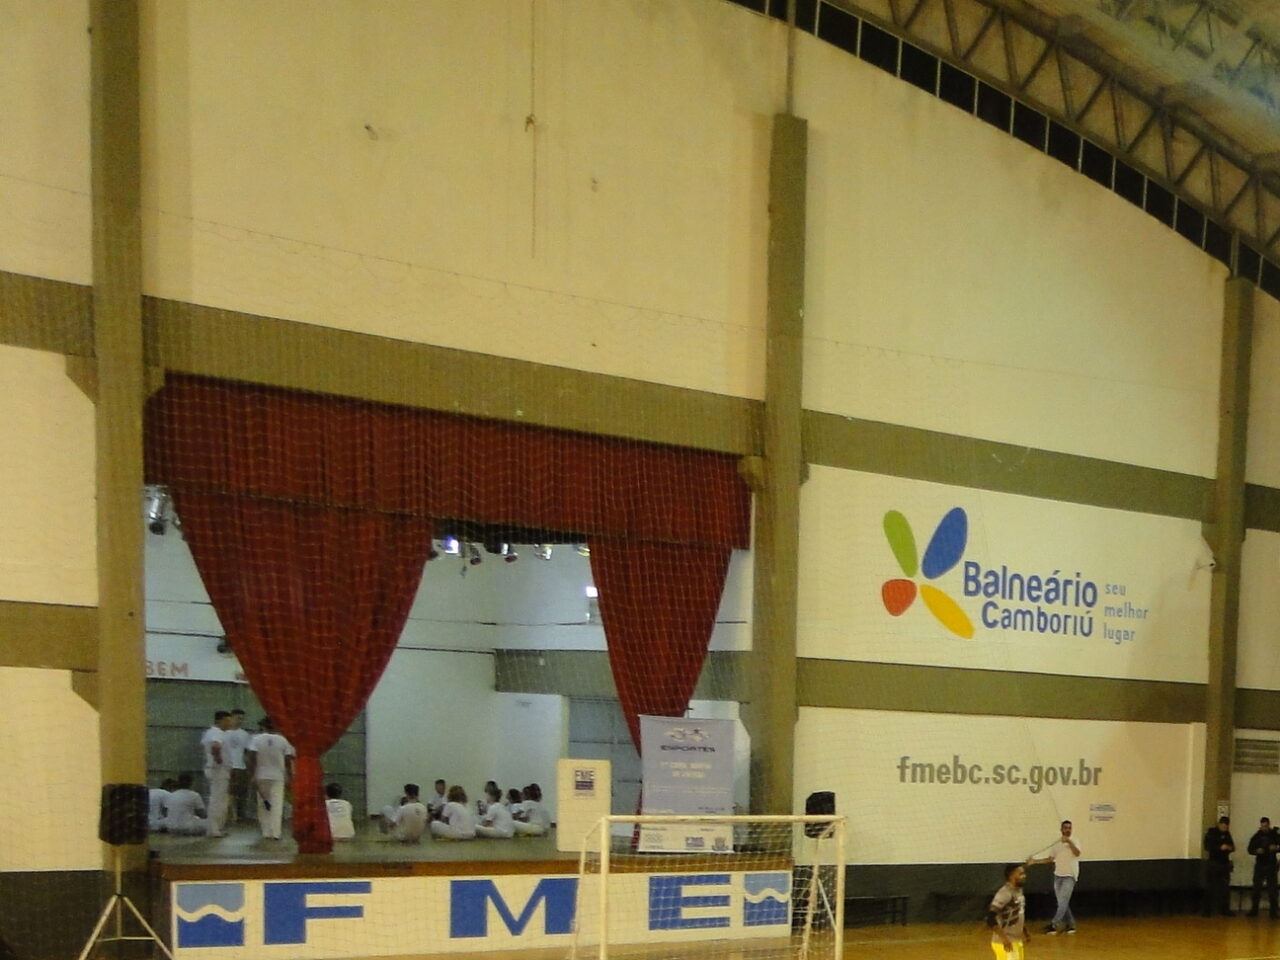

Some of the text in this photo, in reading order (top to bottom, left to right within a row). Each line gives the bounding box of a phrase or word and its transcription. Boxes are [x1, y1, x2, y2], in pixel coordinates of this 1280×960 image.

[963, 560, 1098, 608] Balneário
[1105, 583, 1126, 596] seu
[981, 601, 1093, 637] Camboriú
[1104, 602, 1149, 620] melhor
[1103, 623, 1136, 645] lugar
[896, 755, 1103, 794] fmebc.sc.gov.br
[263, 874, 732, 946] FME
